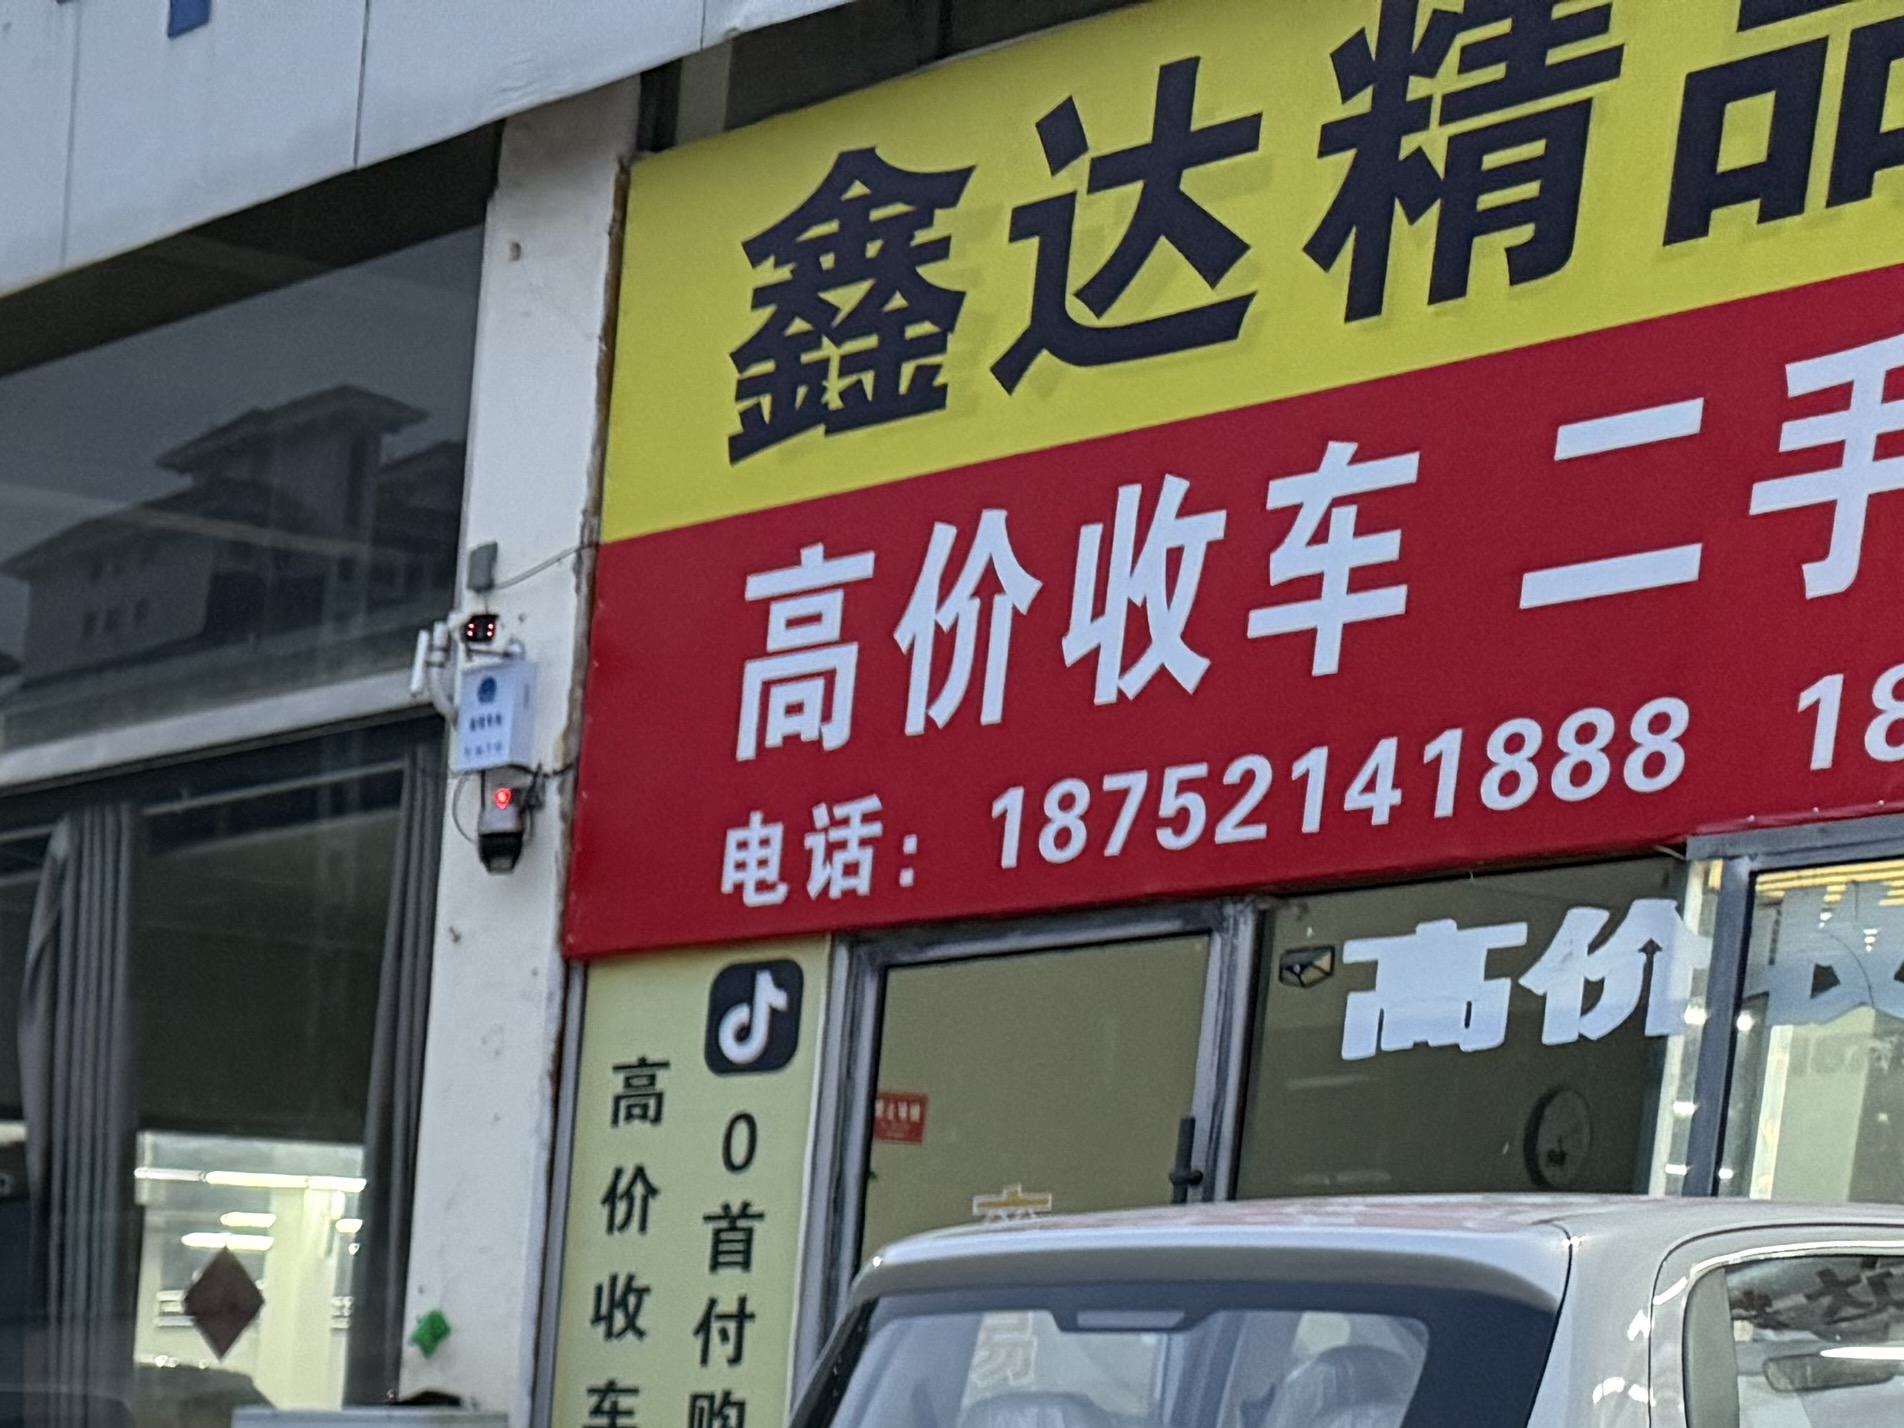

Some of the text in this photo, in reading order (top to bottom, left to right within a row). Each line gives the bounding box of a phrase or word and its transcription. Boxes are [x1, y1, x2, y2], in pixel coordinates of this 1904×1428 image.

[735, 333, 1904, 762] 高价收车 二手
[990, 697, 1690, 868] 18752141888
